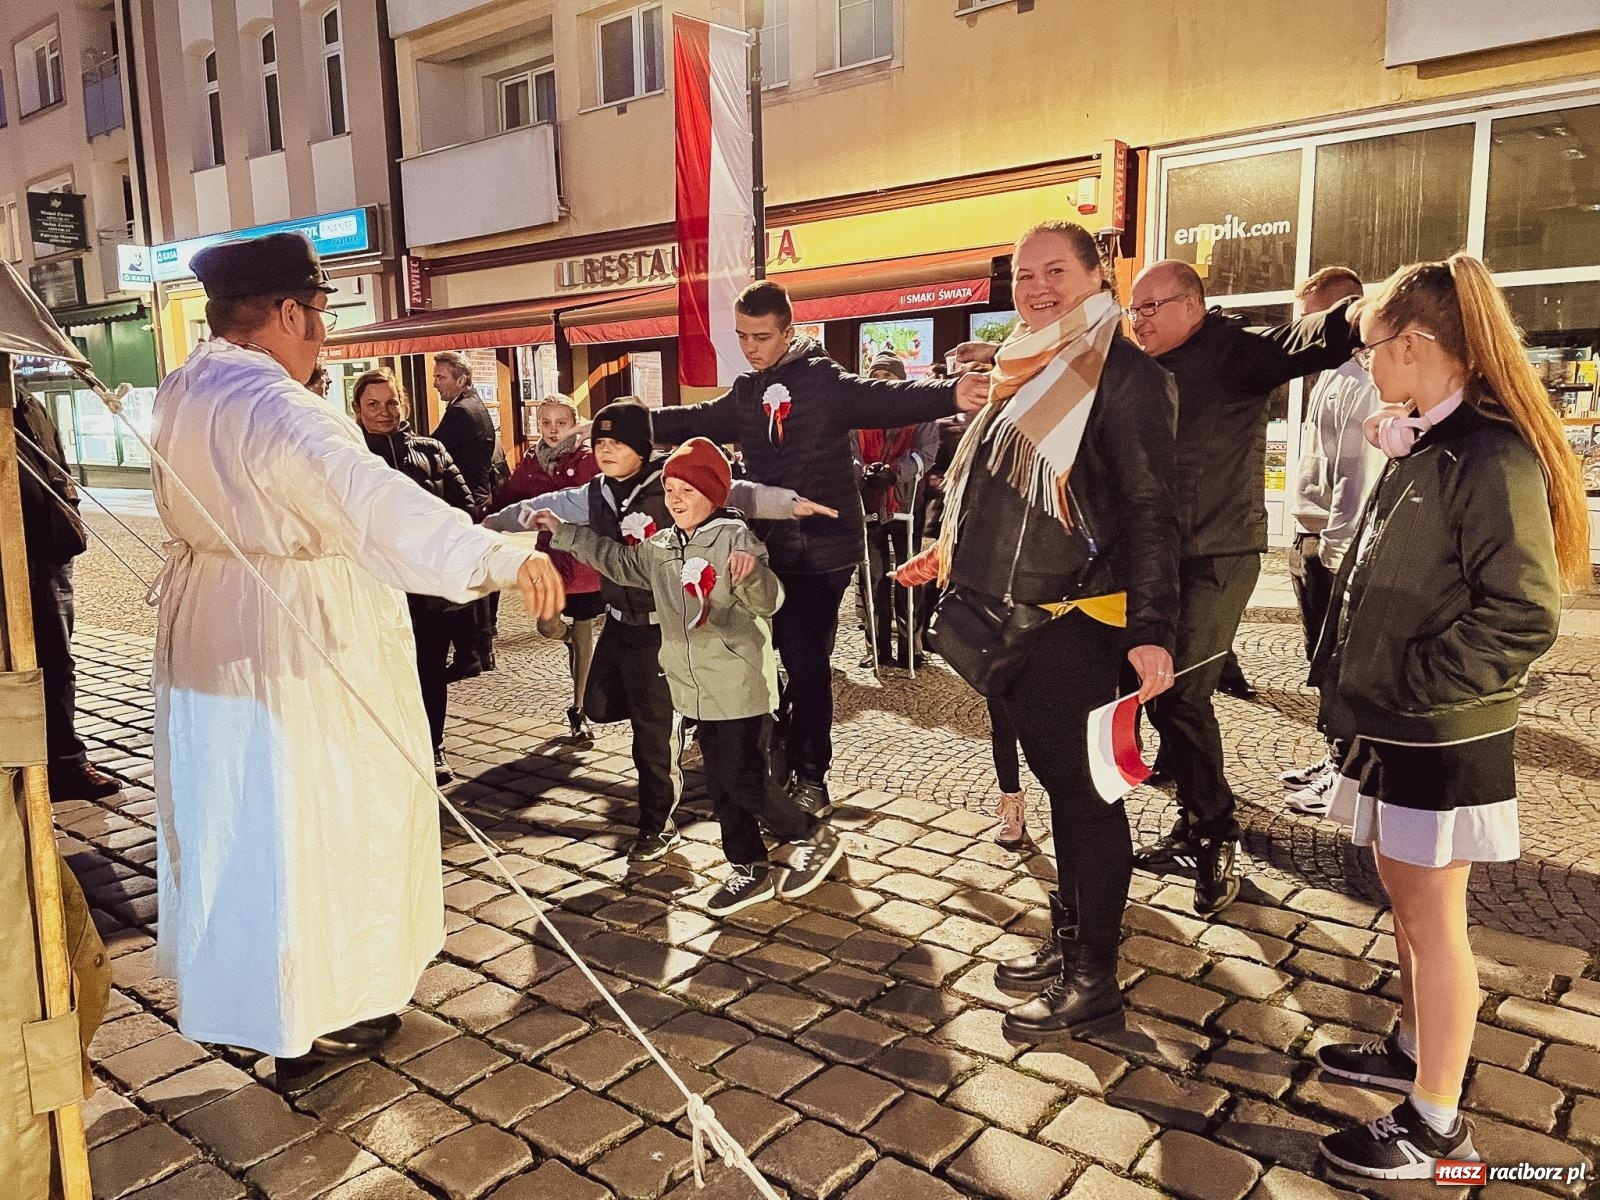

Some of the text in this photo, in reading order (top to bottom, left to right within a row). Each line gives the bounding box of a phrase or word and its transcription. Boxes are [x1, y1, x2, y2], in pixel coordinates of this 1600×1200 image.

[1174, 214, 1291, 245] empik.com
[410, 260, 422, 304] ŻYWIEC
[906, 287, 972, 304] SMAKI ŚWIATA
[1265, 443, 1287, 451] OPOLY
